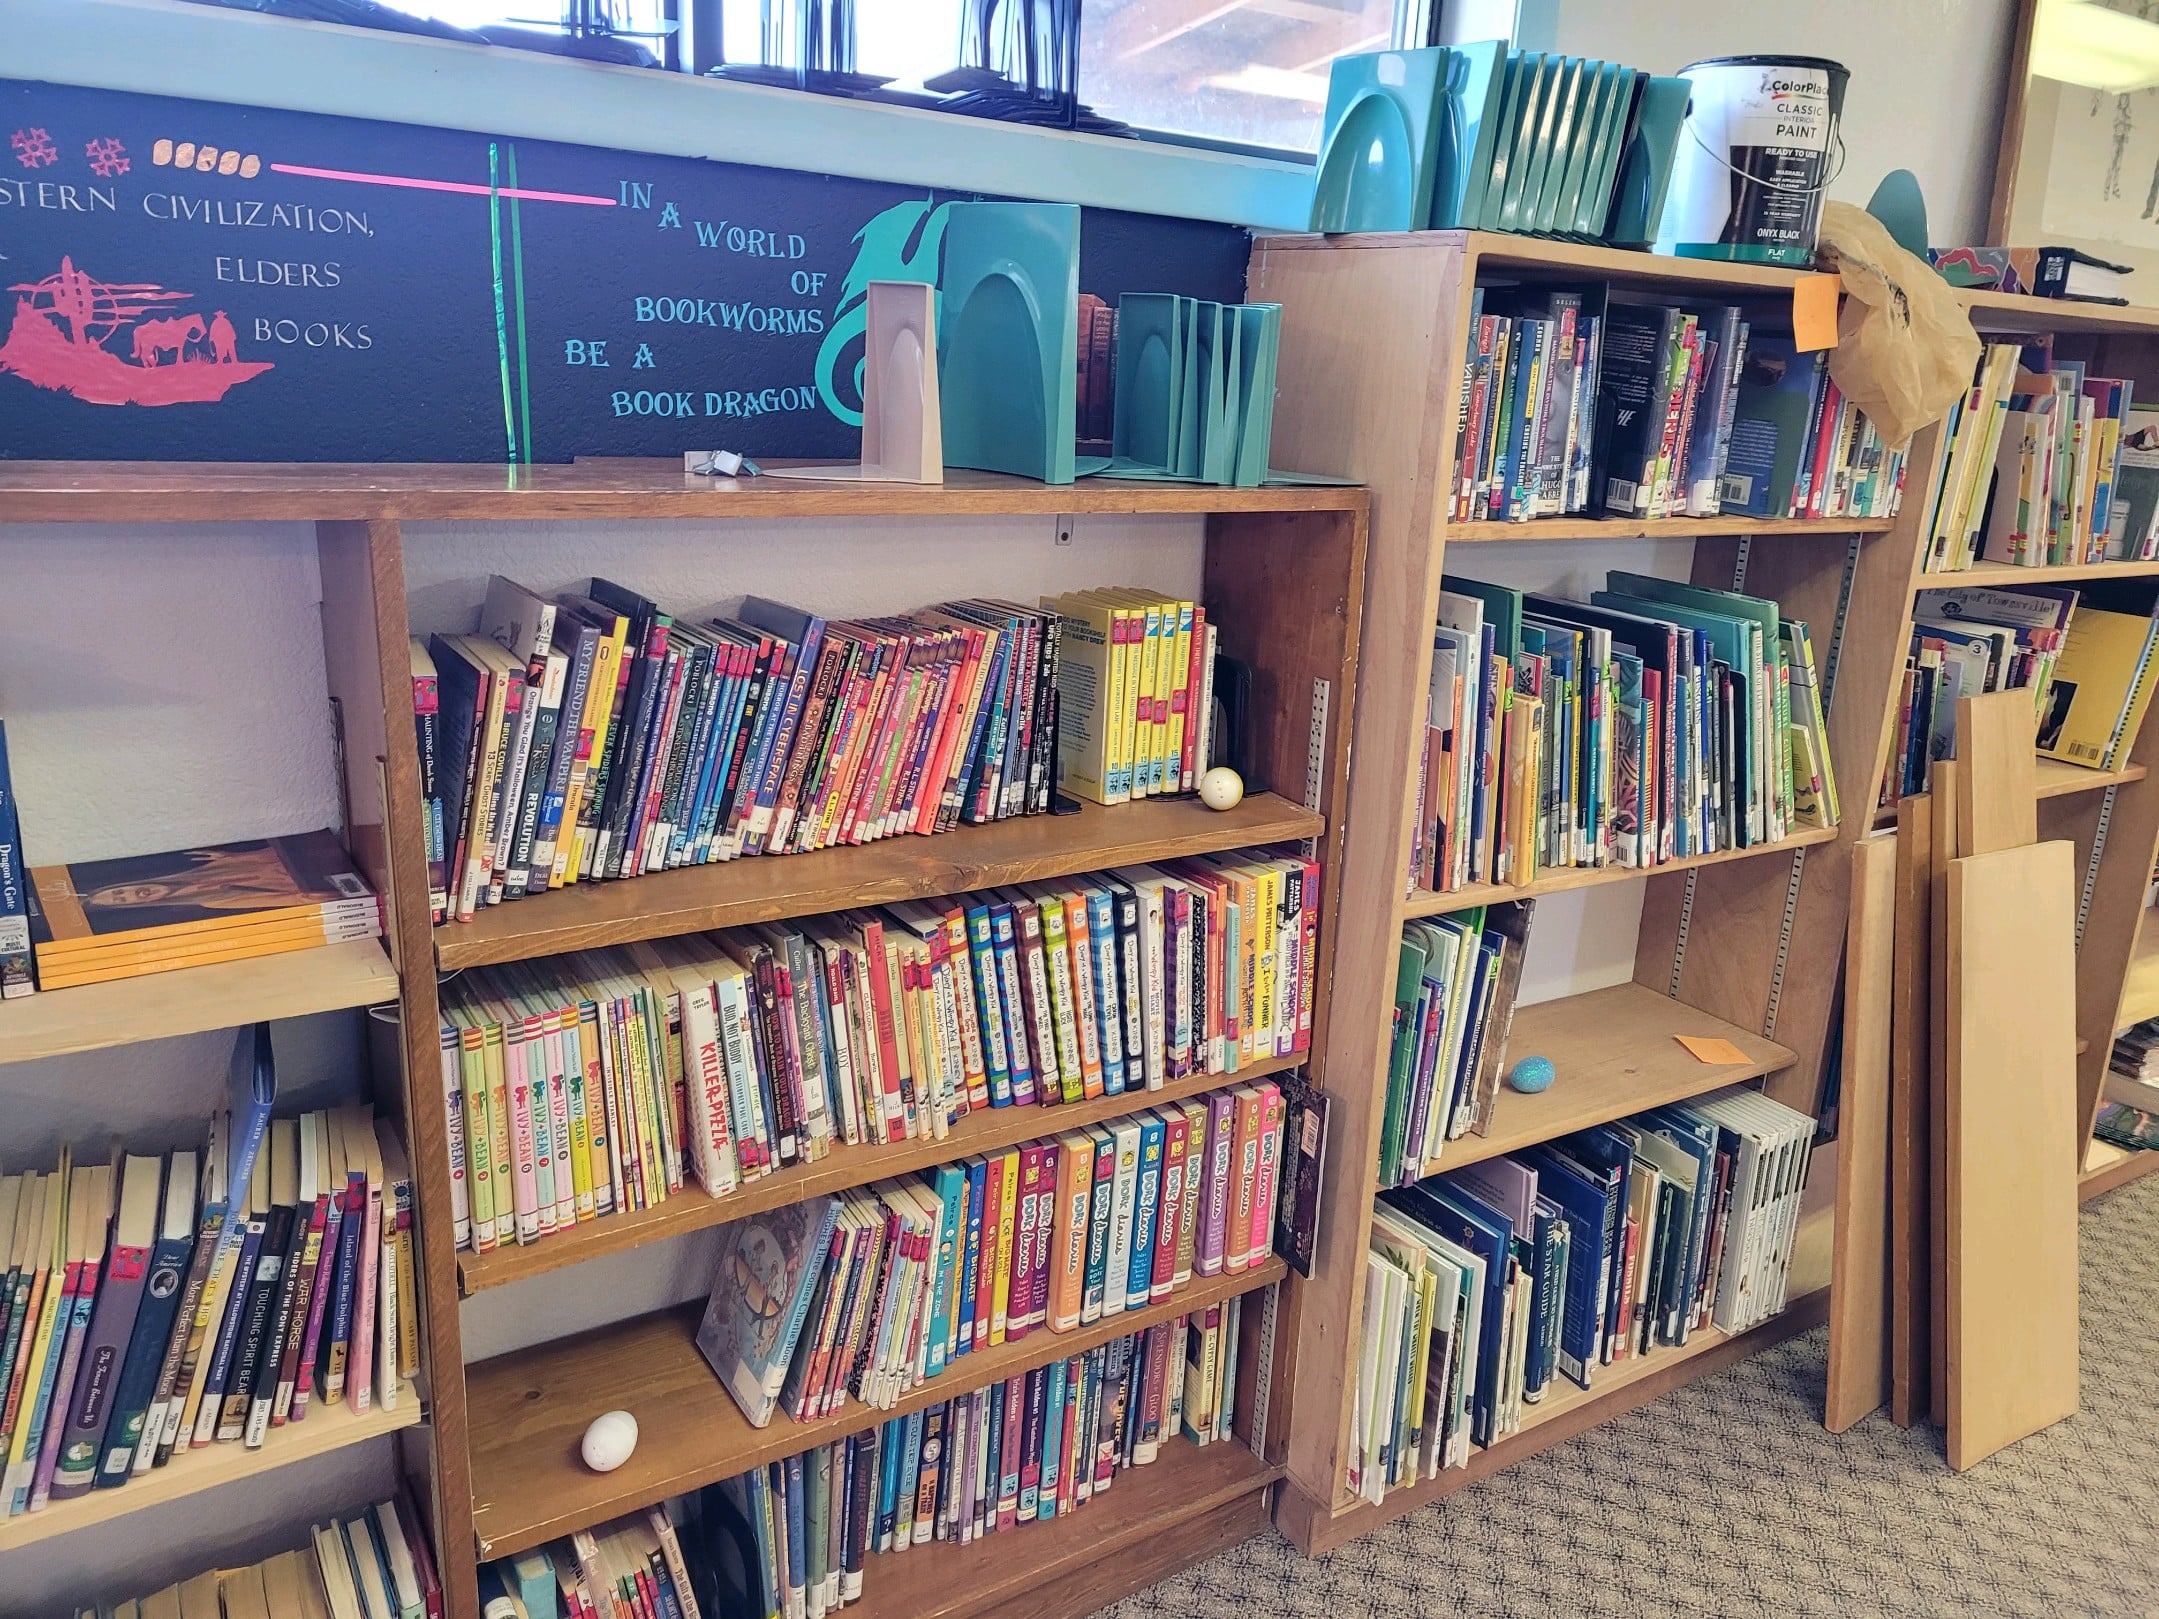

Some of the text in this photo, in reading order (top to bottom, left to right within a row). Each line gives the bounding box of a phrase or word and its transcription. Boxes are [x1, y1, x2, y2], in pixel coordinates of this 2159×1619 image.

[1776, 124, 1817, 138] PAINT
[1777, 104, 1823, 116] CLASSIC
[1765, 147, 1793, 157] READY
[1805, 150, 1817, 159] USE
[143, 192, 375, 238] CIVILIZATION,
[619, 181, 806, 259] IN A WORLD
[1757, 228, 1800, 239] ONYX BLACK
[216, 256, 341, 288] ELDERS
[791, 270, 827, 296] OF
[254, 318, 373, 350] BOOKS
[635, 296, 824, 336] BOOKWORMS
[565, 340, 656, 369] BE A
[611, 386, 817, 419] BOOK DRAGON
[1457, 363, 1474, 433] VANISHED
[1660, 389, 1684, 459] NERDS
[1948, 589, 1968, 602] City
[1970, 592, 1982, 602] of
[1987, 595, 2055, 613] Townsville!
[524, 691, 538, 721] Orange
[555, 640, 594, 793] MY FRIEND THE VAMPIRE
[521, 722, 532, 736] You
[763, 670, 809, 795] LOST IN CYBERSPACE
[495, 723, 510, 785] BRUCE COVILLE
[593, 722, 617, 815] SEVEN SPIDERS SPINNING
[476, 750, 497, 836] 13 SCARY GHOST STORIES
[502, 811, 515, 838] Amber
[518, 792, 538, 862] REVOLUTION
[0, 844, 17, 909] Dragon's Gate
[1293, 880, 1302, 911] JAMES
[724, 1004, 742, 1065] BUD, NOT BUDDY
[771, 1013, 780, 1032] HOW
[797, 983, 816, 1067] The Backyard Ghost
[701, 1043, 723, 1100] KILLER
[775, 1045, 785, 1070] TRAIN
[838, 1048, 850, 1070] BOY
[779, 1072, 788, 1094] YOUR
[782, 1097, 792, 1129] DRAGON
[1211, 1144, 1228, 1217] DORK diaries
[1240, 1143, 1257, 1216] DORK diaries
[1257, 1133, 1274, 1207] DORK diaries
[1024, 1197, 1036, 1228] DORK
[1097, 1187, 1109, 1218] DORK
[1118, 1178, 1131, 1208] DORK
[1137, 1172, 1155, 1250] DORK diaries
[1162, 1168, 1181, 1245] DORK diaries
[1182, 1157, 1200, 1233] DORK diaries
[345, 1235, 355, 1258] Island
[1018, 1233, 1032, 1277] diaries
[1069, 1194, 1086, 1273] DORK diaries
[1091, 1222, 1106, 1264] diaries
[1113, 1214, 1128, 1256] diaries
[340, 1285, 350, 1302] Blue
[342, 1270, 351, 1282] the
[1540, 1225, 1555, 1319] THE STAR GUIDE
[1623, 1254, 1635, 1305] FOSSILS
[269, 1251, 301, 1368] RIDERS OF THE PONY EXPRESS
[288, 1278, 310, 1351] WAR HORSE
[337, 1304, 348, 1338] Dolphins
[780, 1248, 827, 1367] Here comes Charlie Moon
[159, 1279, 202, 1396] More Perfect than the Moon
[237, 1288, 270, 1395] TOUCHING SPIRIT BEAR
[1152, 1332, 1168, 1385] SPLENDORS
[84, 1351, 111, 1424] The Fences Between Us
